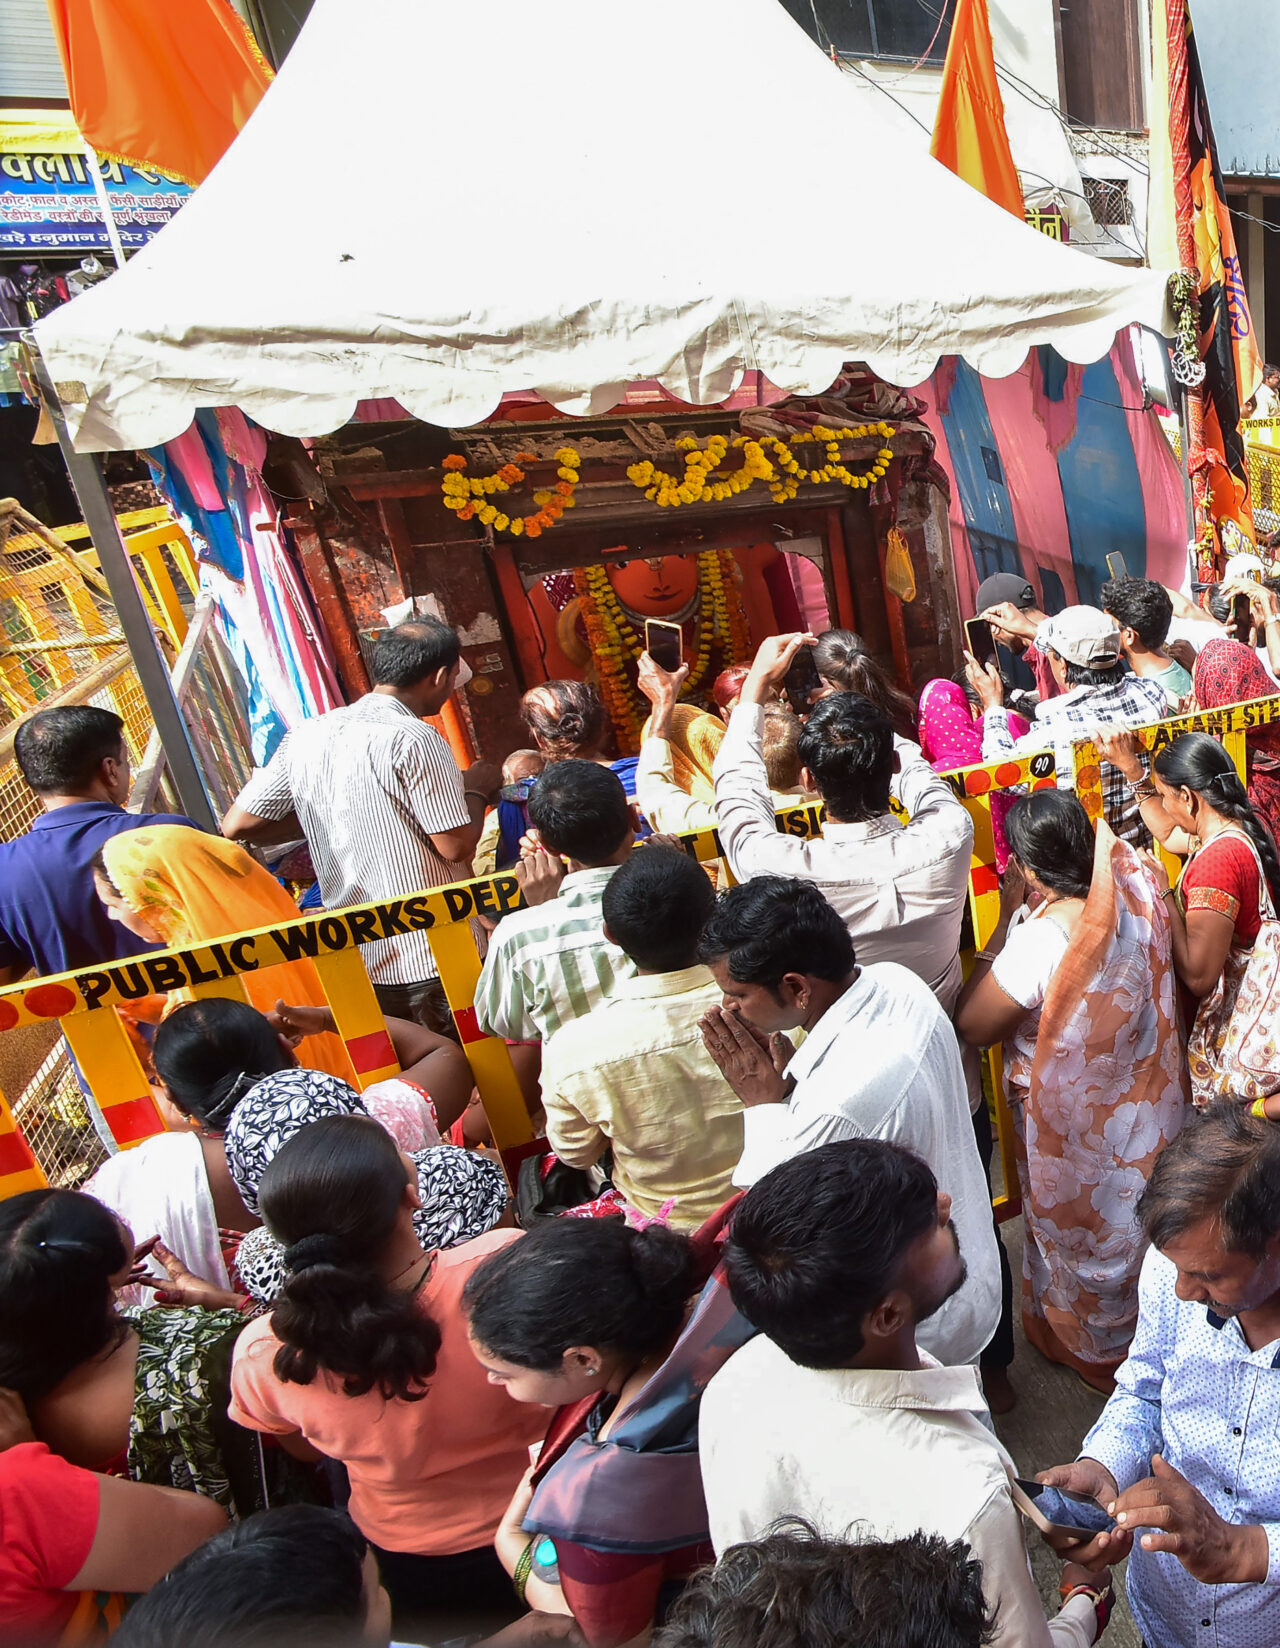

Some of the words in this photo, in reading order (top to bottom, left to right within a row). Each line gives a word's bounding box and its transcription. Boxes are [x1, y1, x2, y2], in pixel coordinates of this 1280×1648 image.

[29, 232, 95, 245] हनुमान
[1246, 417, 1274, 428] WORKS
[1034, 757, 1050, 773] 90
[75, 937, 258, 1011] PUBLIC
[265, 896, 436, 962] WORKS
